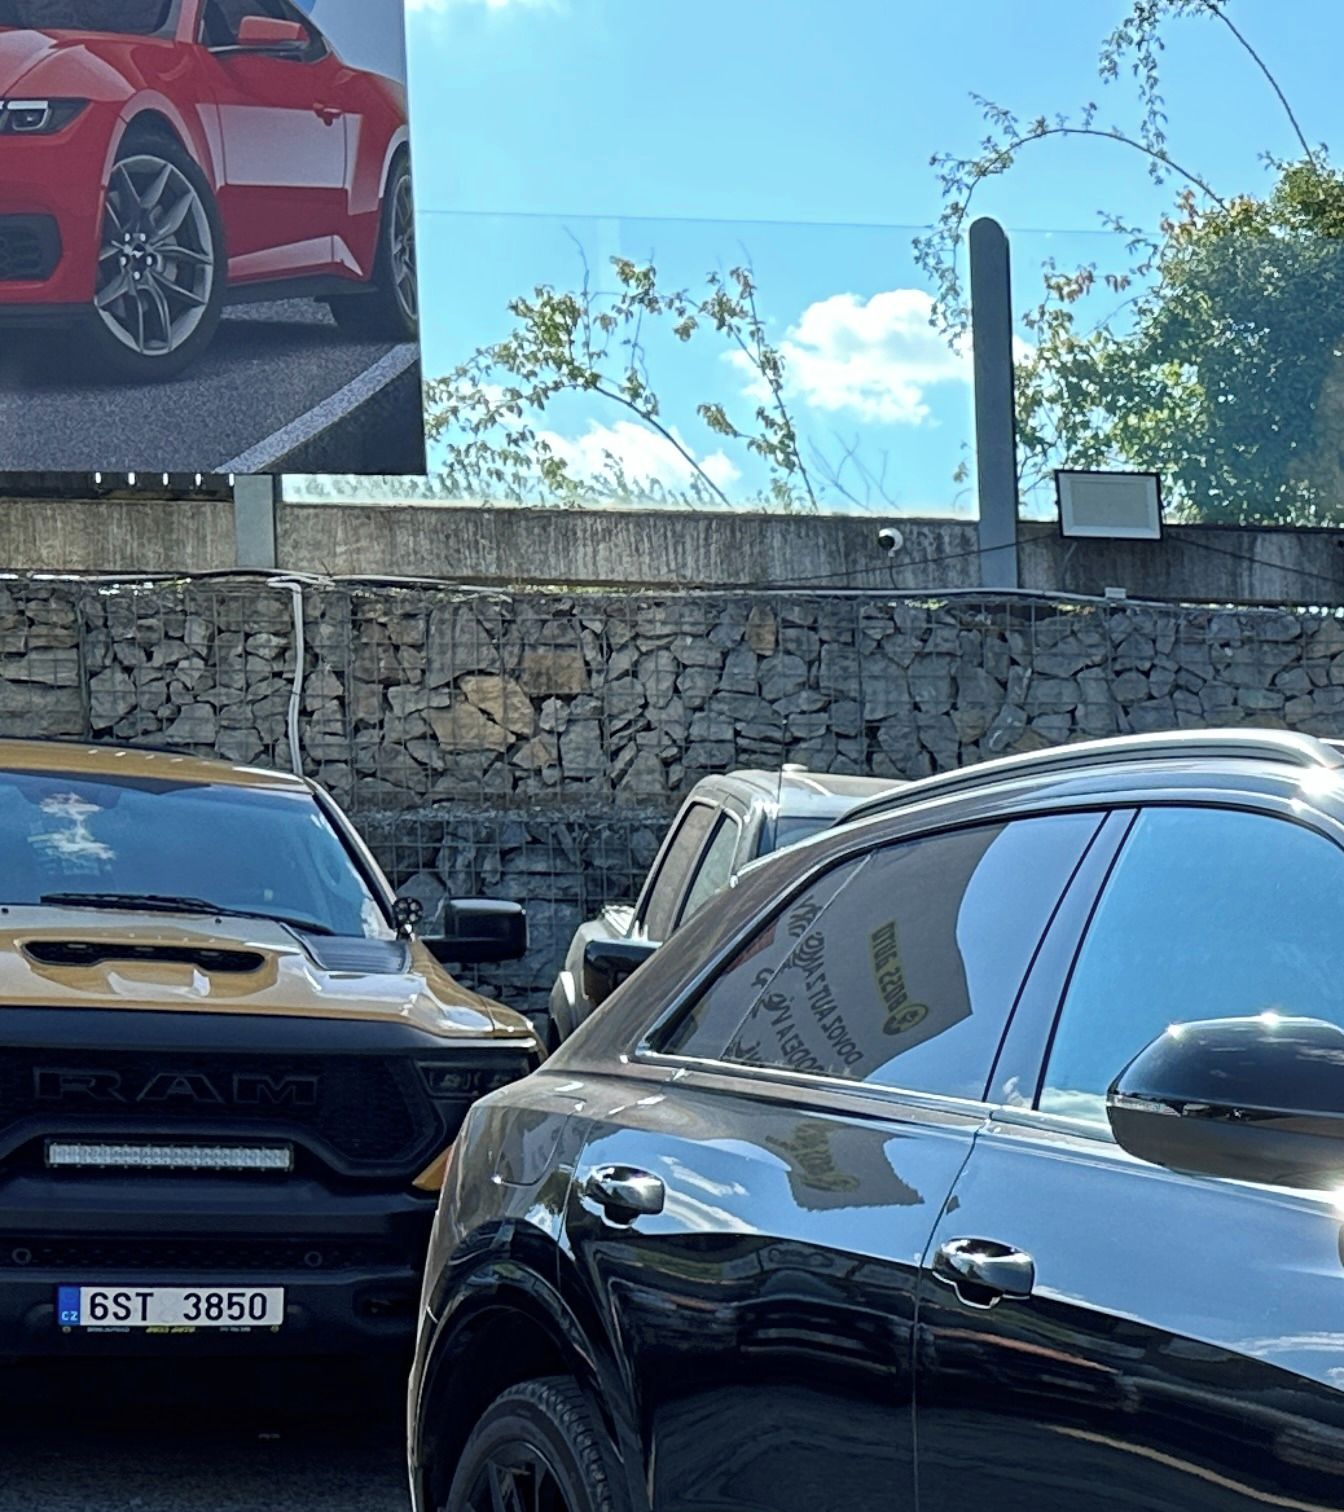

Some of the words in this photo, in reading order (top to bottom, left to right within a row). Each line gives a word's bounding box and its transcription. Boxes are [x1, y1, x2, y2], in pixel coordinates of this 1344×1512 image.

[37, 1068, 318, 1105] RAM
[61, 1310, 79, 1321] CZ
[89, 1292, 154, 1321] 6ST
[183, 1292, 267, 1321] 3850
